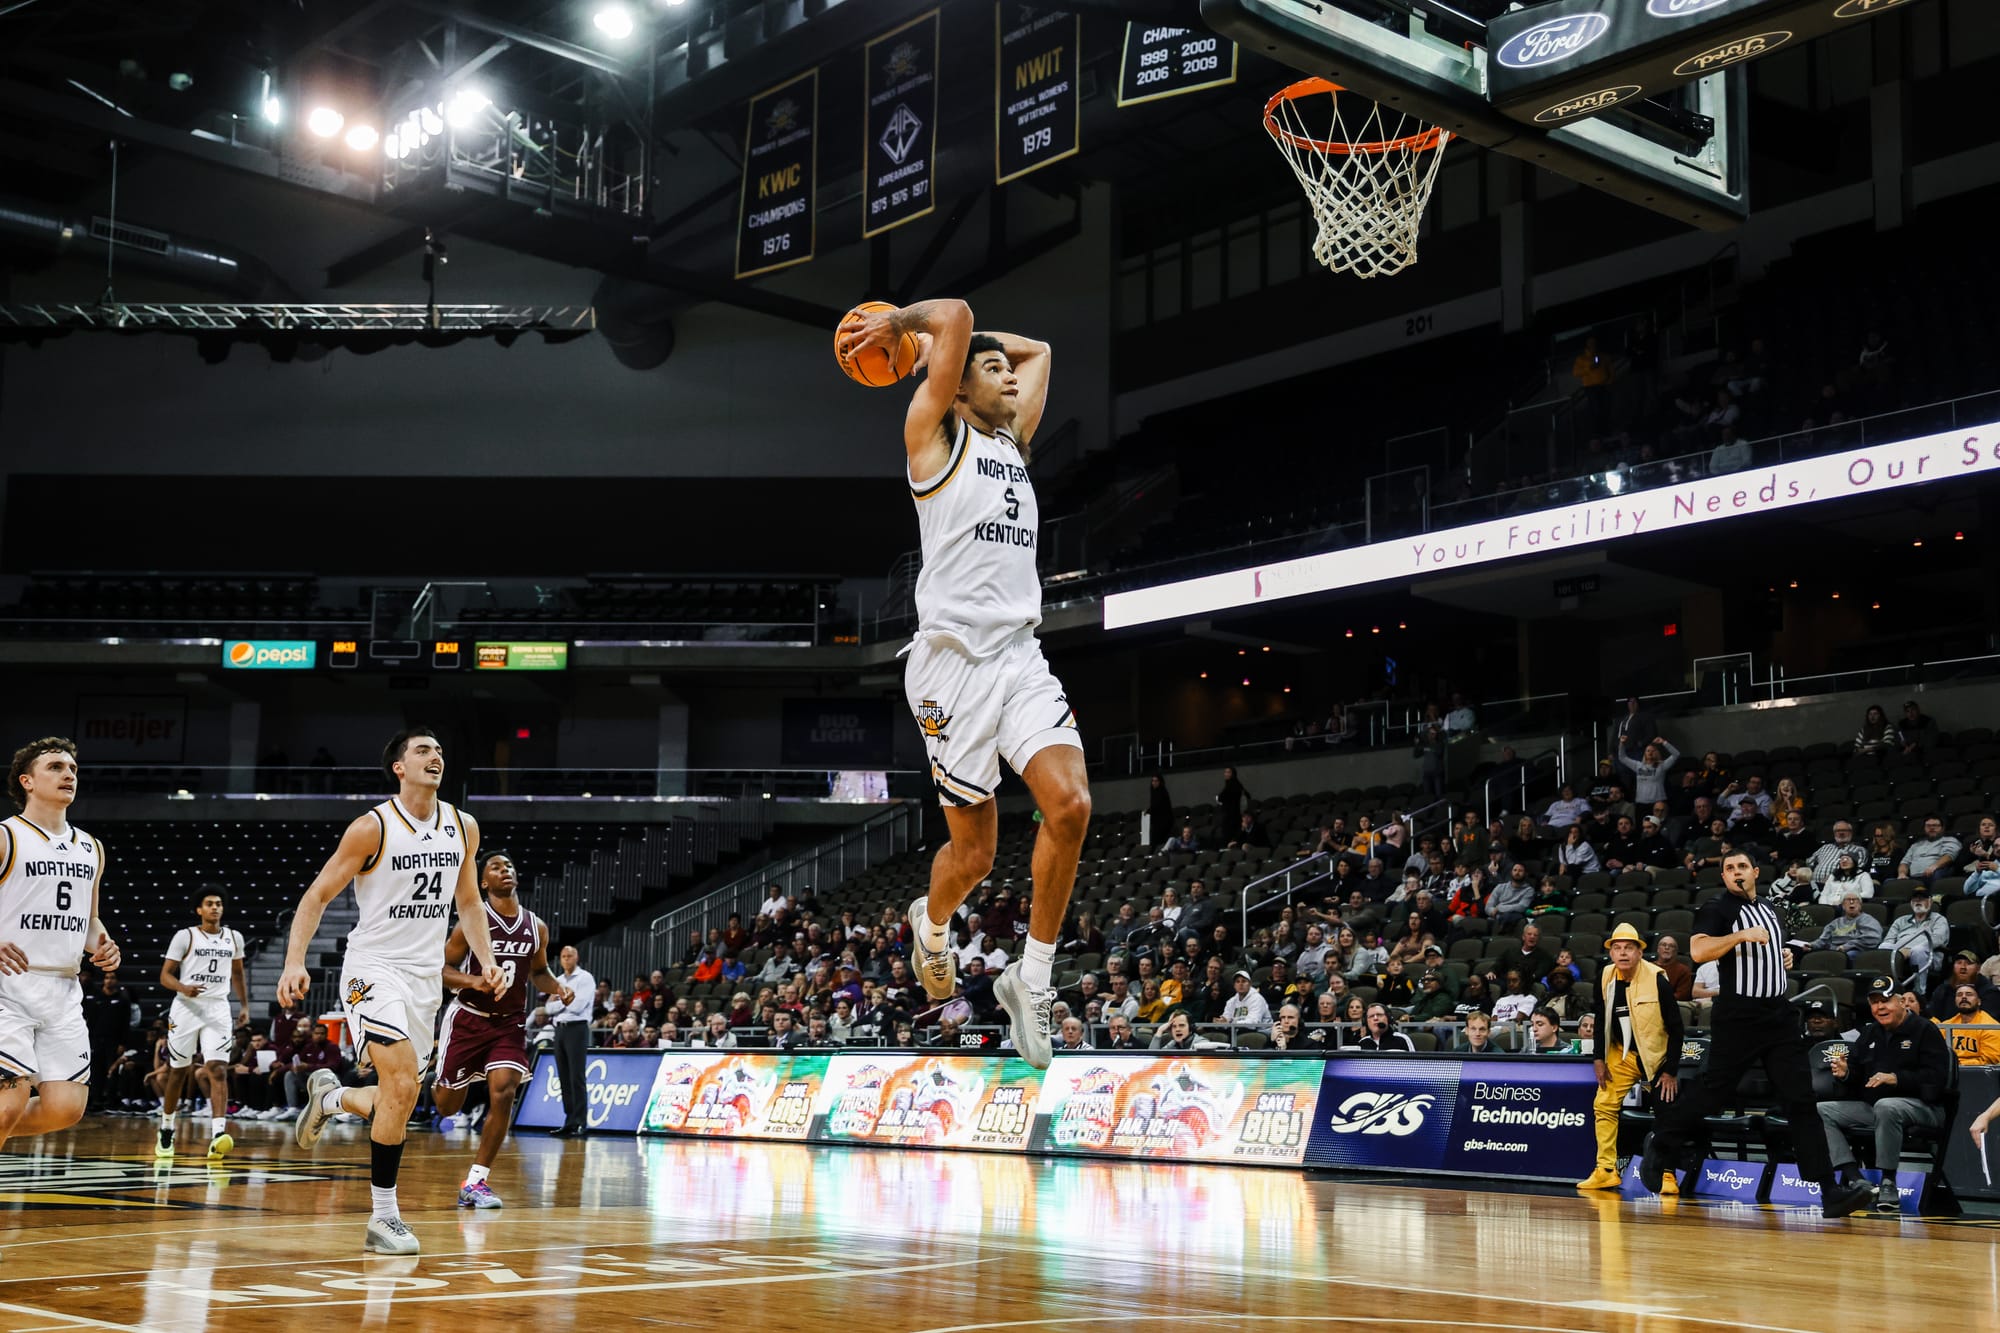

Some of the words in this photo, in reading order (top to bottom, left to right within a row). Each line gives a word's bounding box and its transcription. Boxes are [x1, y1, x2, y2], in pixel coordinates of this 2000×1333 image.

[1140, 49, 1168, 67] 1999
[1181, 39, 1217, 57] 2000
[1518, 22, 1587, 62] Ford
[1693, 38, 1766, 68] Ford
[1015, 46, 1064, 91] NWIT
[1136, 66, 1169, 86] 2006
[1182, 55, 1218, 75] 2009
[1552, 91, 1618, 116] Ford
[1022, 127, 1052, 155] 1979
[758, 163, 801, 199] KWIC
[912, 179, 929, 197] 1977
[748, 198, 806, 229] CHAMPIONS
[763, 233, 791, 256] 1976
[1406, 315, 1433, 336] 201
[1004, 487, 1020, 521] 5
[1413, 537, 1486, 567] Your
[1508, 507, 1647, 550] Facility
[1674, 474, 1817, 519] Needs,
[1848, 454, 1930, 487] Our
[974, 522, 1036, 550] KENTUCK
[257, 646, 307, 663] pepsi
[85, 712, 175, 745] meijer
[818, 713, 860, 728] BUD
[810, 728, 866, 743] LIGHT
[392, 852, 460, 871] NORTHERN
[56, 881, 72, 910] 6
[412, 871, 443, 900] 24
[195, 948, 233, 958] NORTHERN
[491, 940, 532, 954] EKU
[208, 959, 218, 973] 0
[960, 1034, 983, 1045] POSS
[585, 1059, 640, 1127] roger
[993, 1087, 1025, 1104] SAVE
[1257, 1093, 1296, 1112] SAVE
[1474, 1082, 1541, 1101] Business
[769, 1096, 812, 1125] BIG!
[978, 1102, 1029, 1135] BIG!
[1471, 1105, 1585, 1129] Technologies
[1241, 1110, 1304, 1146] BIG!
[1463, 1139, 1528, 1152] gbs-inc.com
[1719, 1169, 1754, 1190] Kroger
